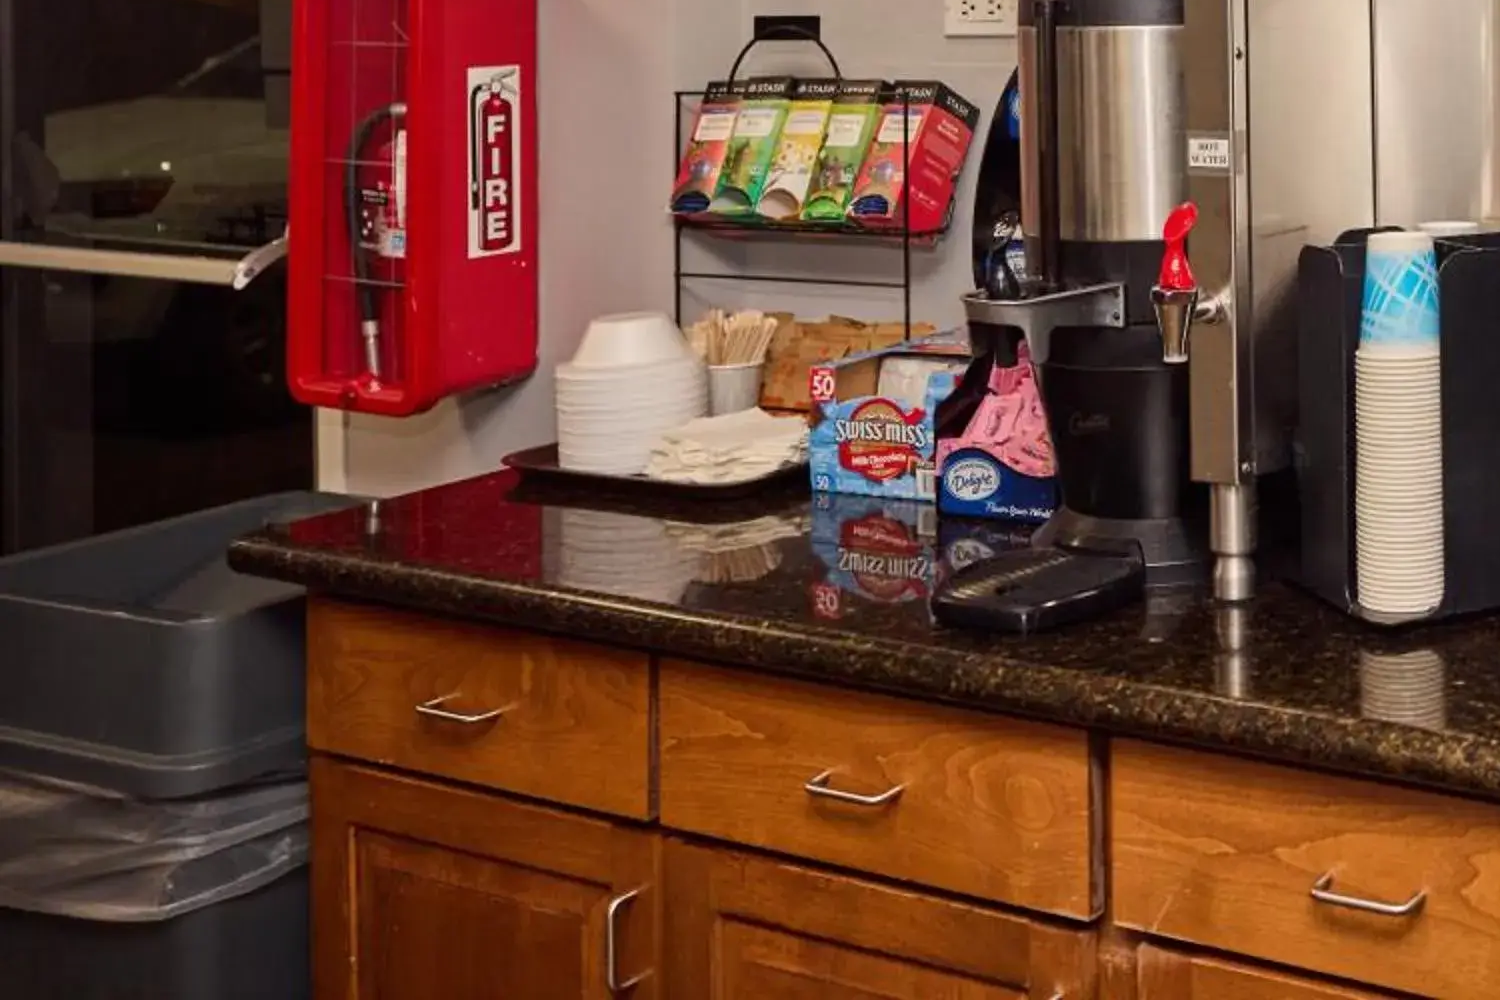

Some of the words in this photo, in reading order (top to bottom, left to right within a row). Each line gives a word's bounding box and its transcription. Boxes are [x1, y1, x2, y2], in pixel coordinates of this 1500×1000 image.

[485, 114, 508, 240] FIRE
[812, 375, 835, 396] 50
[835, 420, 883, 441] SWISS
[886, 422, 926, 448] MISS
